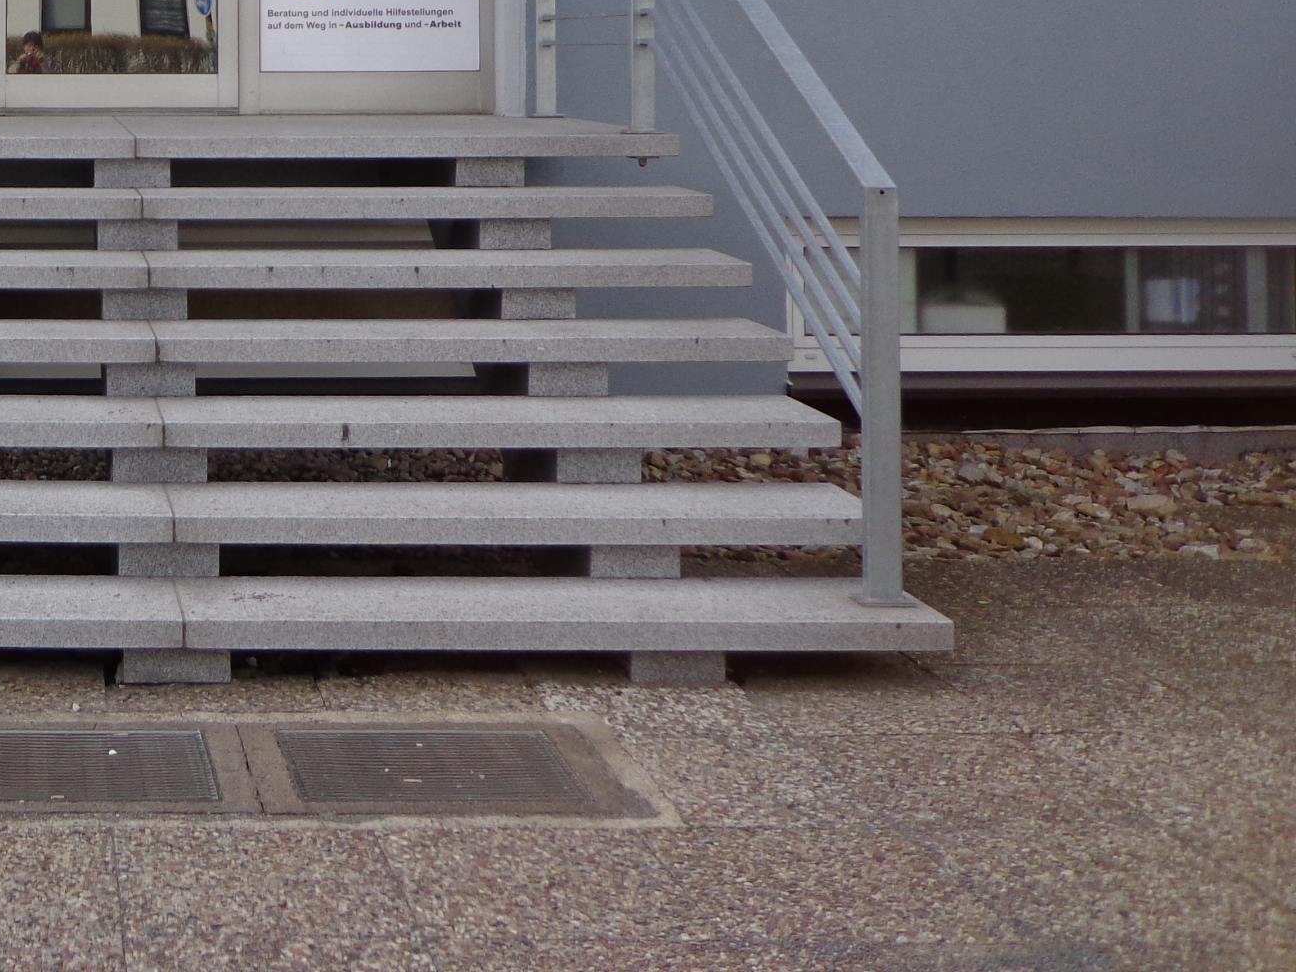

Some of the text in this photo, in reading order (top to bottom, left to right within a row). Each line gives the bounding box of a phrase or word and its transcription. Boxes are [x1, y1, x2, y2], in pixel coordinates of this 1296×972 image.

[267, 8, 454, 18] Beratung und individuelle Hilfestellungen
[267, 21, 282, 30] auf
[284, 21, 304, 30] dem
[306, 21, 326, 31] Weg
[404, 20, 422, 29] und
